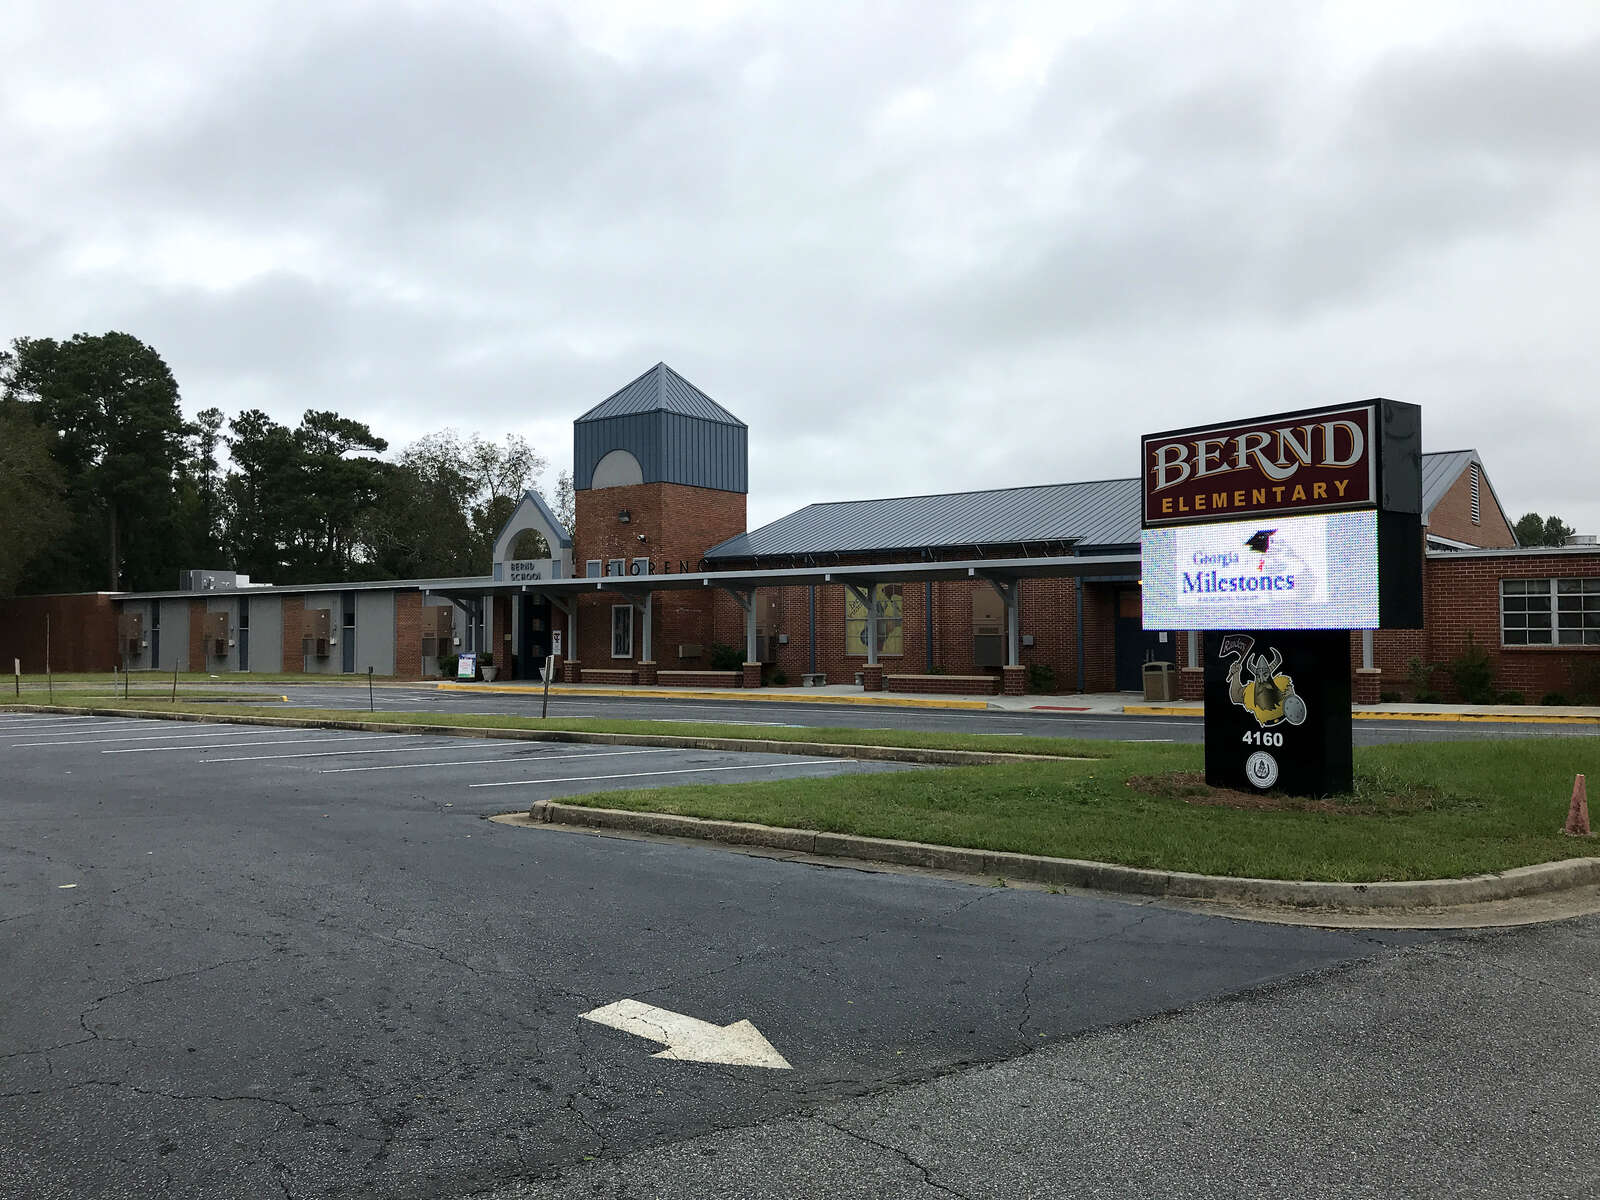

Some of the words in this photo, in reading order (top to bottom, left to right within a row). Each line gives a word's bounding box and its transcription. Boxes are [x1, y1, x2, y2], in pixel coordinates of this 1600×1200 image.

[1151, 420, 1364, 494] BERND
[1162, 480, 1349, 513] ELEMENTARY
[510, 562, 535, 571] BERND
[510, 573, 542, 581] SCHOOL
[1183, 570, 1295, 594] Milestones
[1242, 731, 1284, 747] 4160
